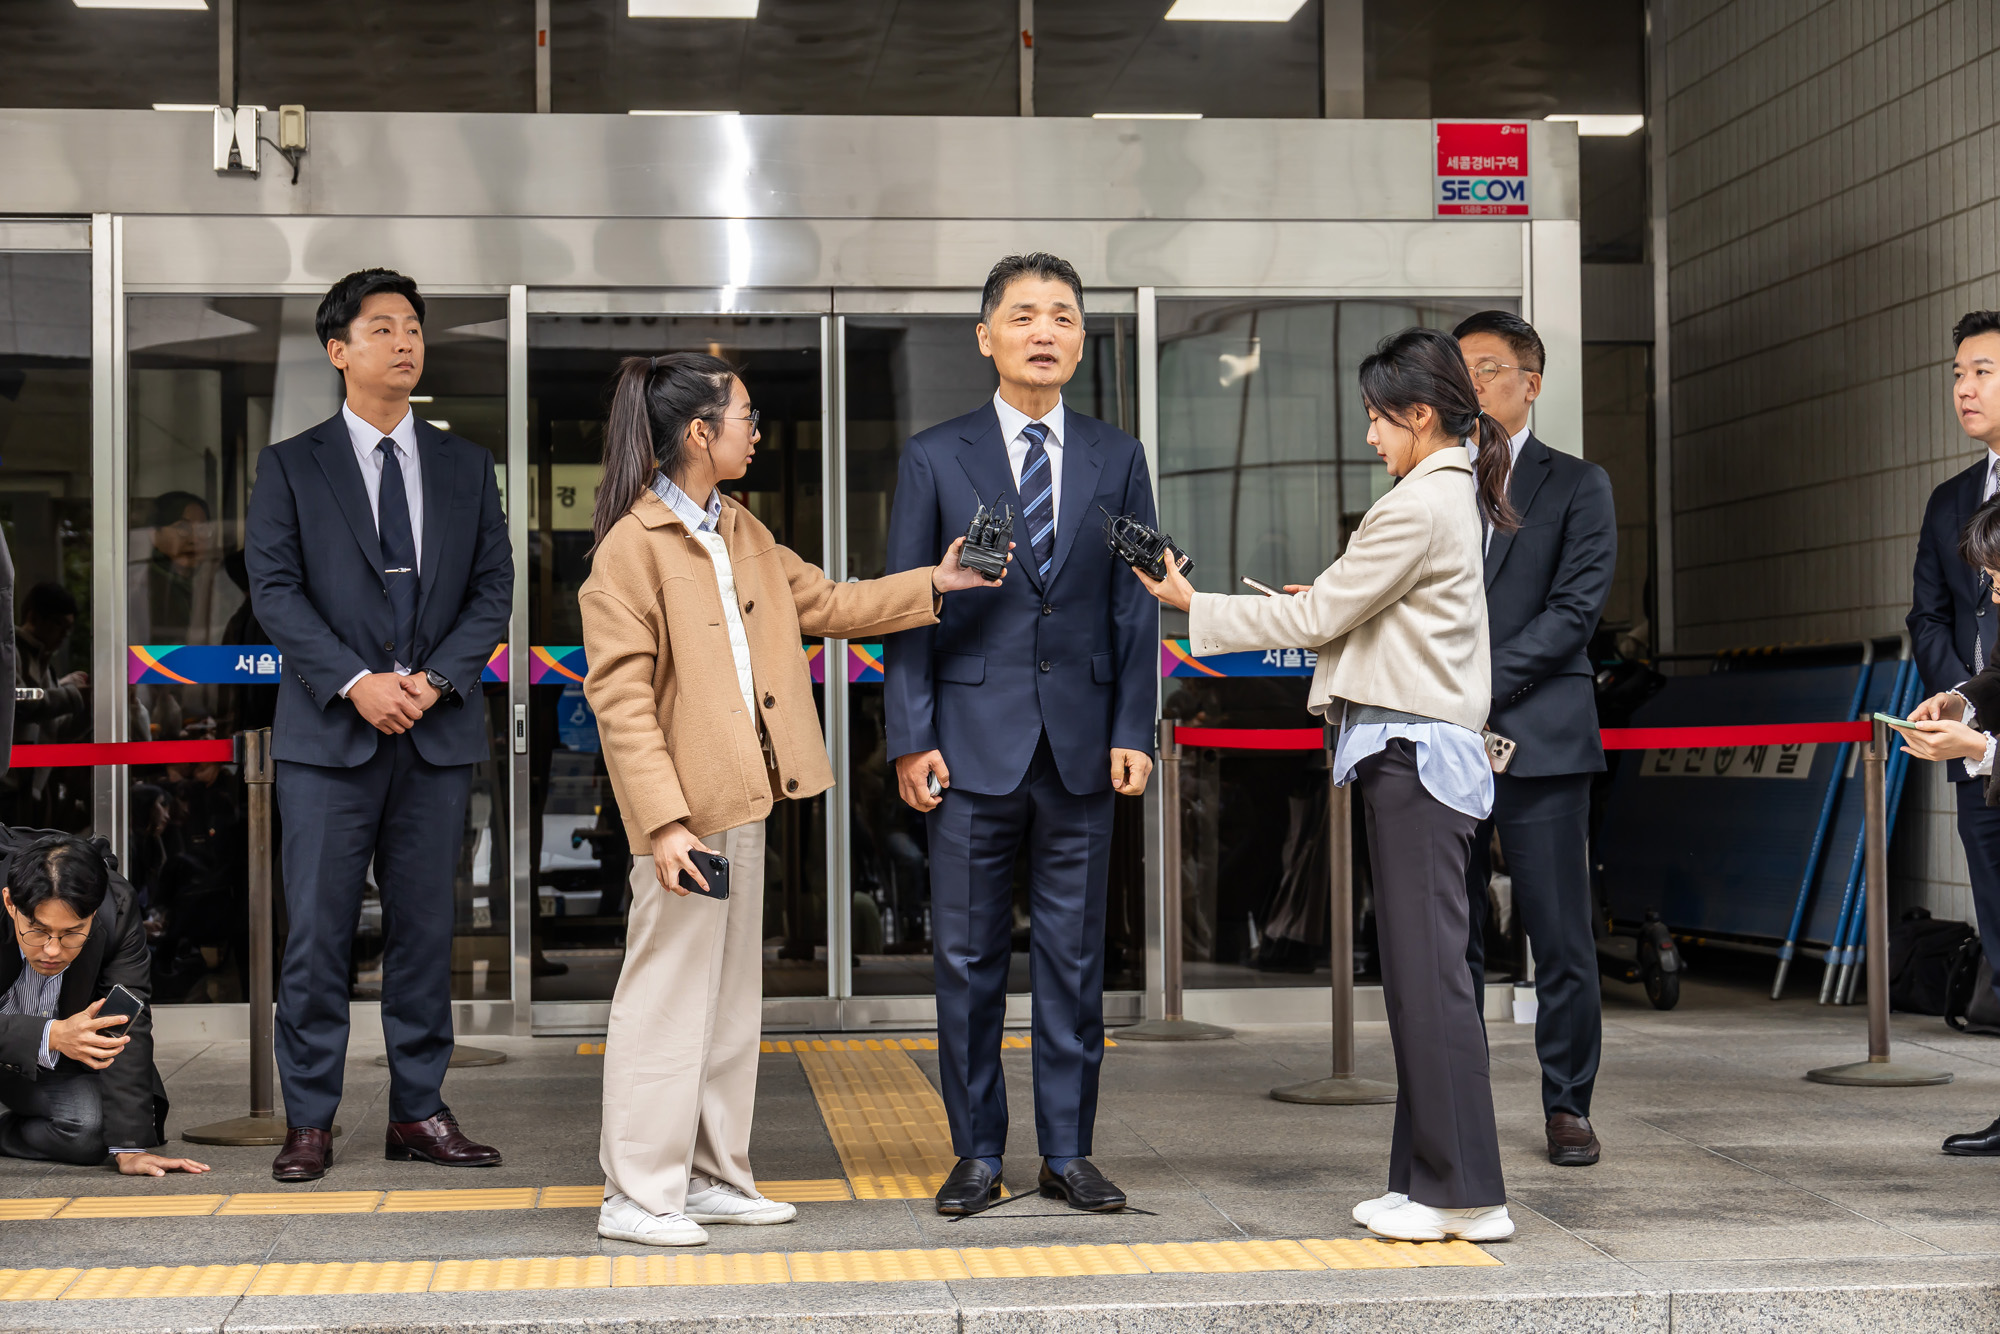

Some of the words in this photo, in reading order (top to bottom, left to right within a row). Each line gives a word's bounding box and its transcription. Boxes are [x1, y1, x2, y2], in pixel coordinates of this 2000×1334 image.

[1446, 156, 1519, 170] 세콤경비구역
[1441, 179, 1525, 201] SECOM
[1460, 205, 1507, 214] 1588-3112
[235, 653, 282, 674] 서울
